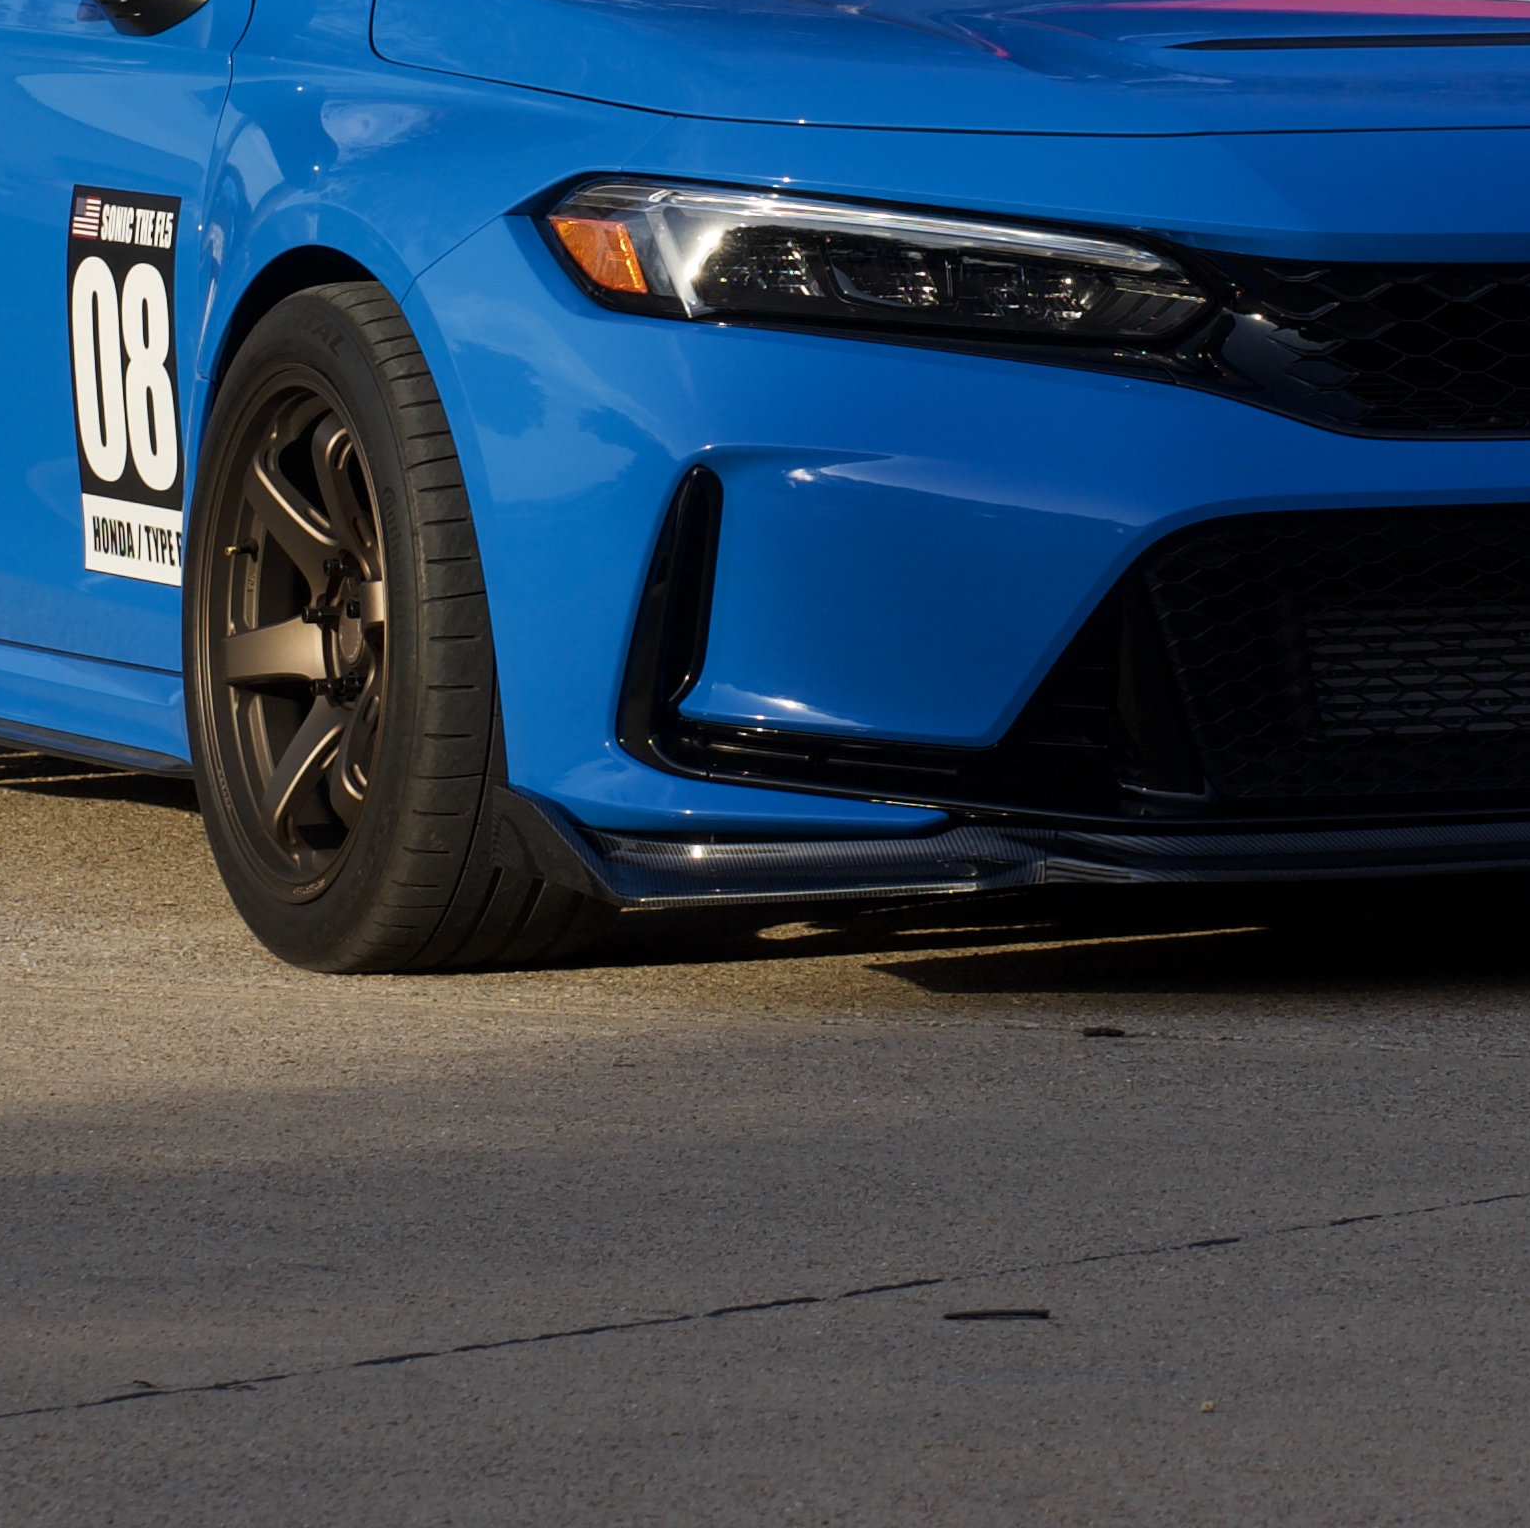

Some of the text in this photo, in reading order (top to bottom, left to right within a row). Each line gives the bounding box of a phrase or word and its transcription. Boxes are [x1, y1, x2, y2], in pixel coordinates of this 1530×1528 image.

[100, 204, 174, 249] SONIC THE FL5
[72, 256, 178, 492] 08
[93, 515, 135, 559] HONDA
[144, 525, 176, 567] TYPE
